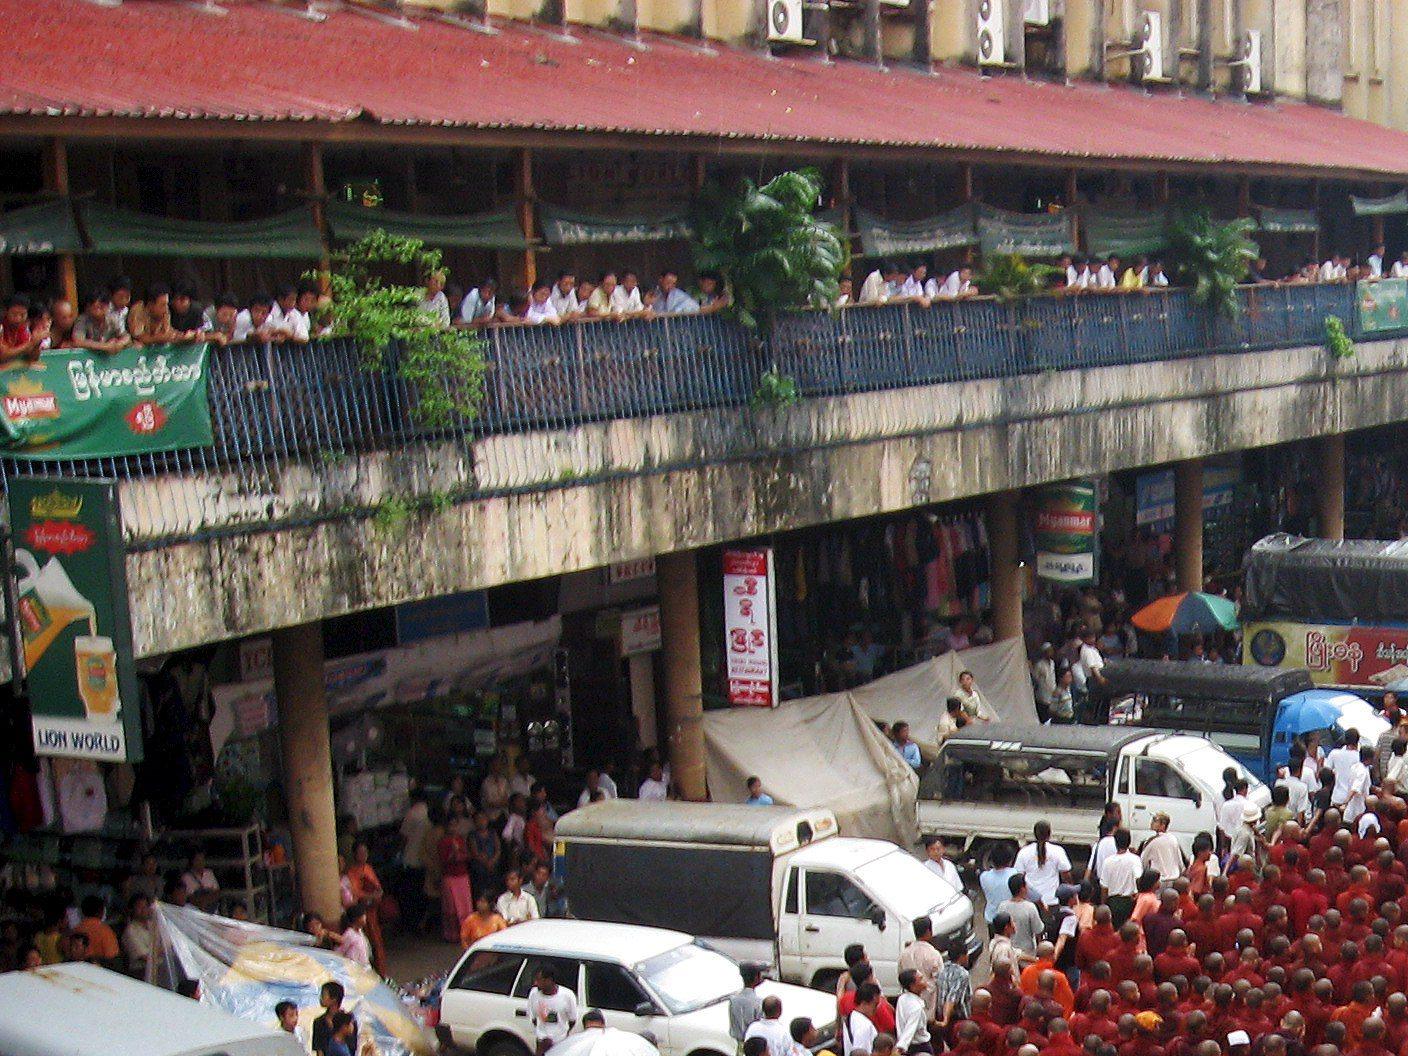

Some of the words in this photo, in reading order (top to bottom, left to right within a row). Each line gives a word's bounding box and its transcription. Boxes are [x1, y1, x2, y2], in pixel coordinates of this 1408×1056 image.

[1038, 513, 1093, 528] Myanmar
[38, 728, 68, 749] LION
[72, 732, 121, 754] WORLD
